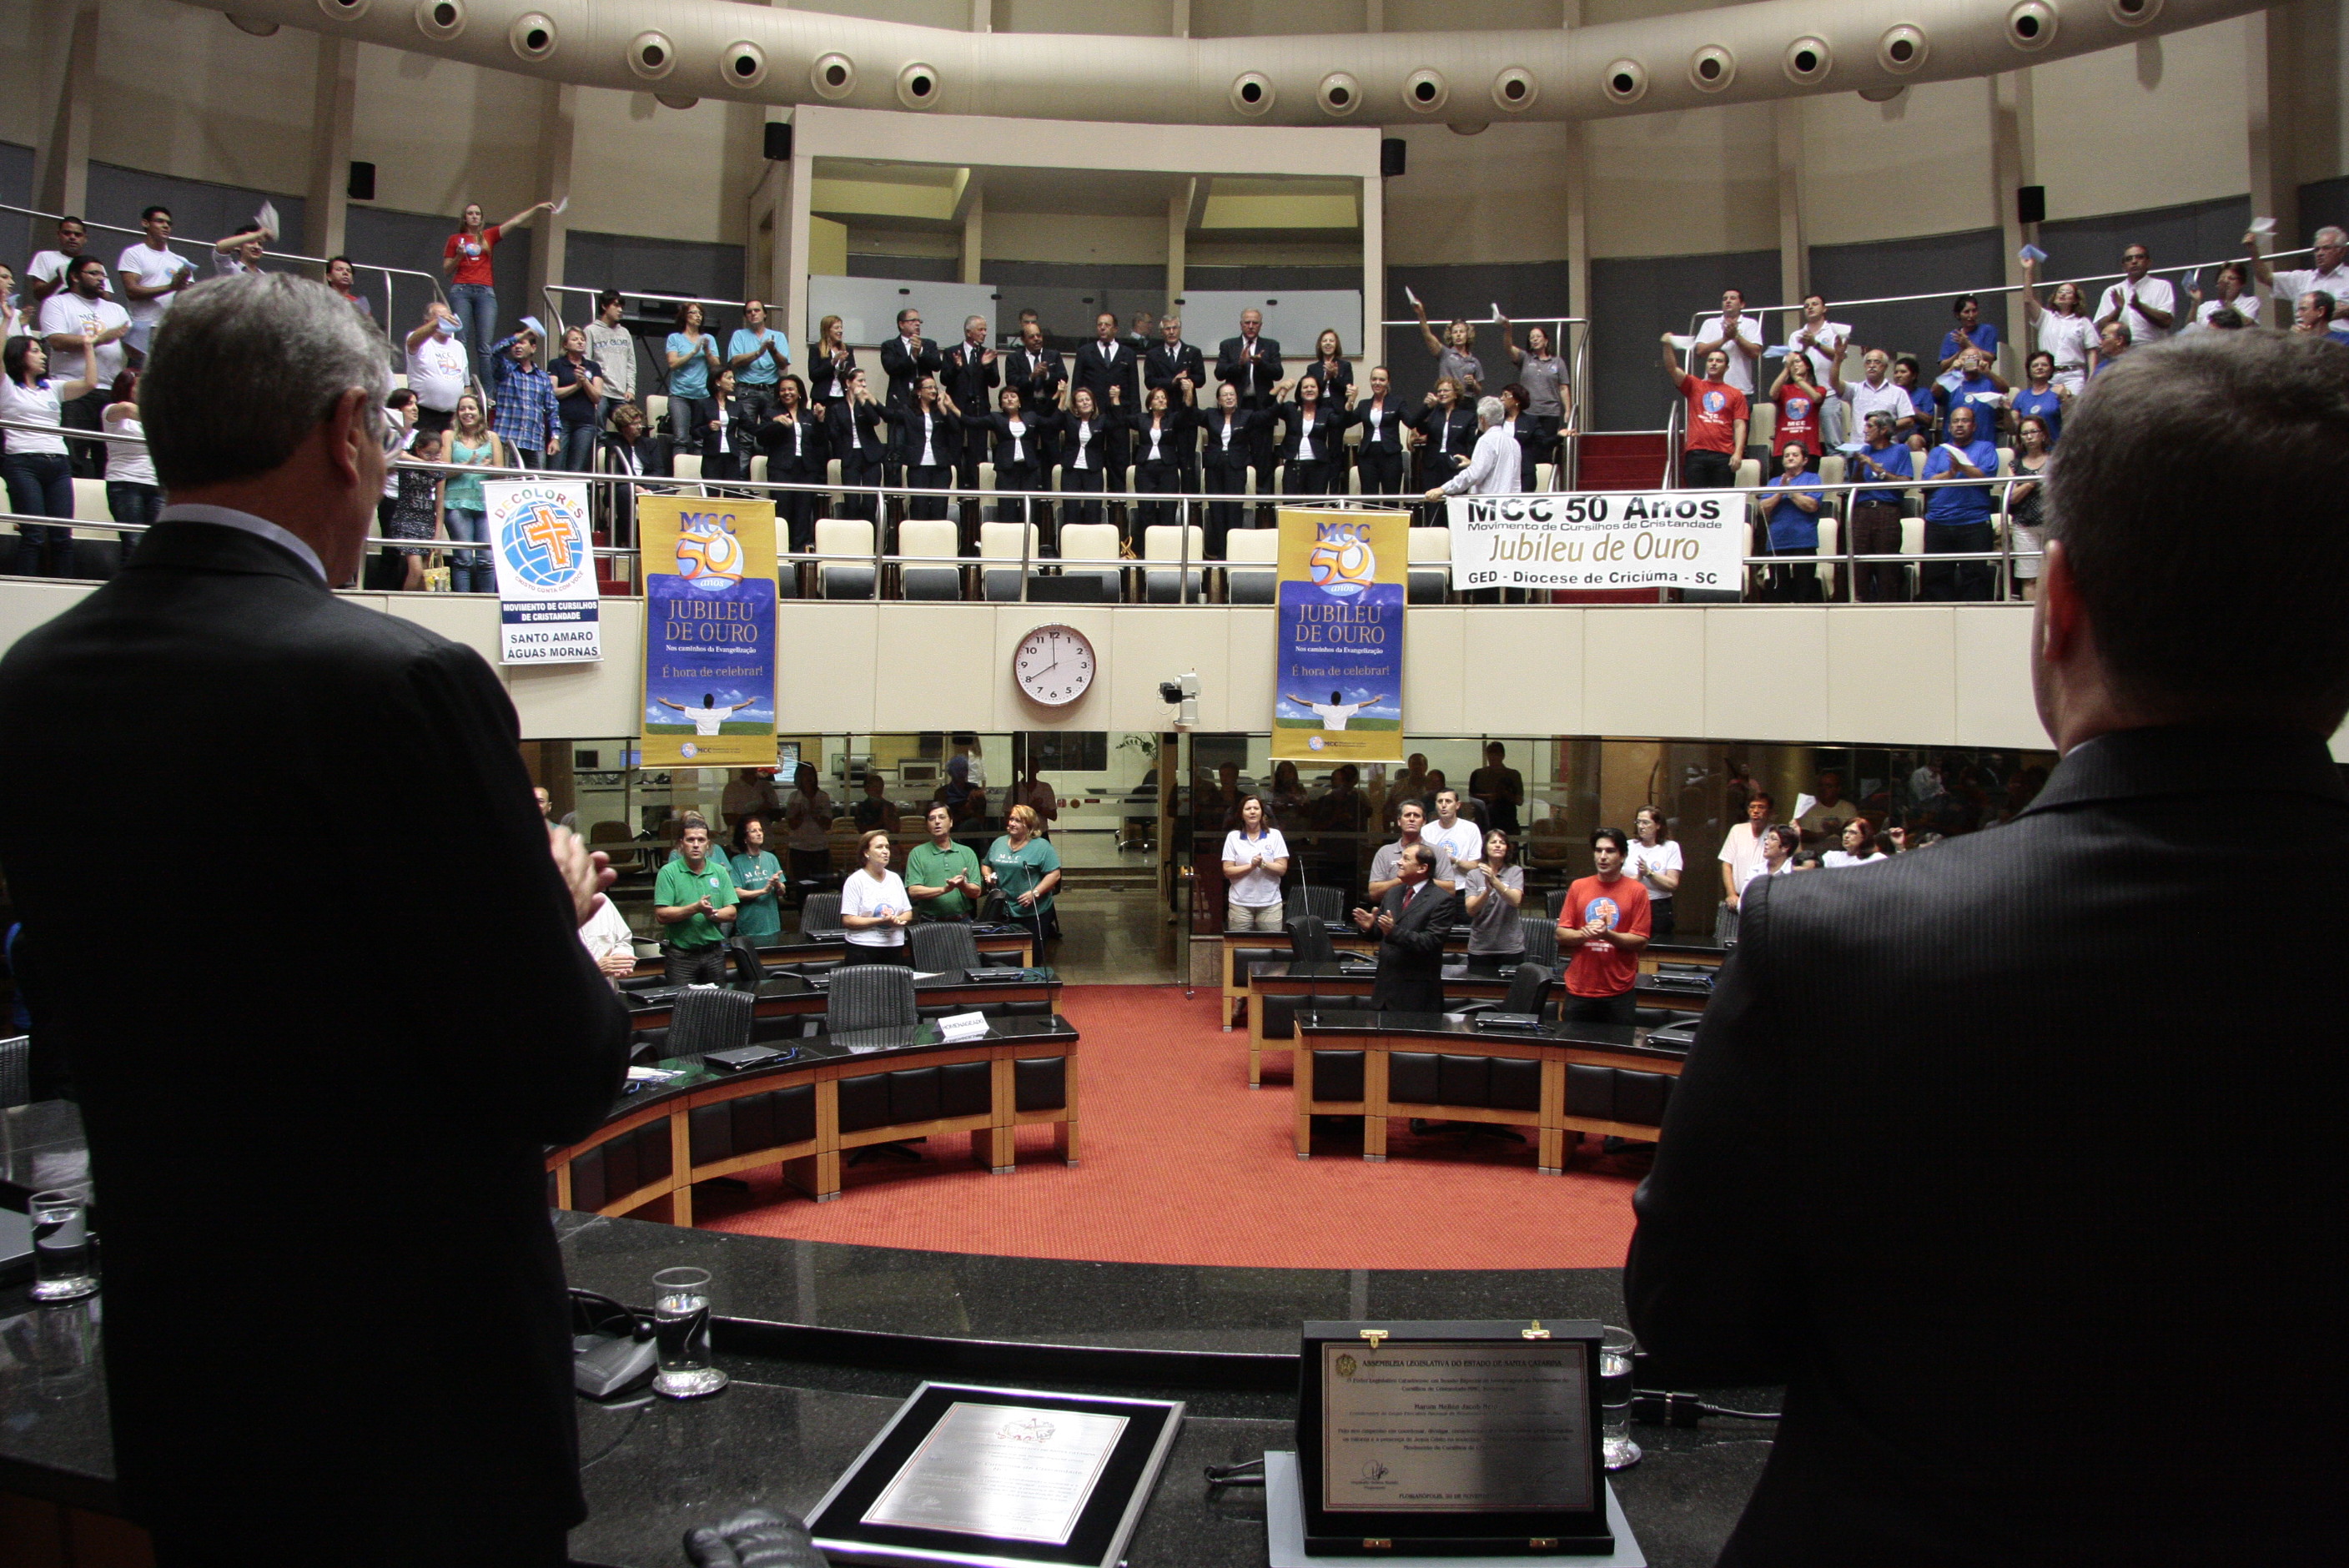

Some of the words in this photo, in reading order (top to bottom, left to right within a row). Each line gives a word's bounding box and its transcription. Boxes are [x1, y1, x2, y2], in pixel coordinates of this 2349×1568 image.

[495, 488, 584, 520] DECOLORES
[1467, 497, 1554, 523] MCC
[1566, 495, 1608, 523] 50
[1623, 495, 1721, 521] Anos
[679, 511, 736, 535] MCC
[1467, 520, 1539, 531] Movimento
[1542, 522, 1557, 530] de
[1560, 521, 1620, 531] Cursilhos
[1622, 520, 1637, 530] de
[1639, 519, 1723, 530] Cristandade
[1315, 522, 1371, 543] MCC
[677, 530, 739, 580] 50
[1592, 532, 1625, 562] de
[1632, 531, 1700, 560] Ouro
[1310, 539, 1371, 586] 50
[701, 578, 724, 588] anos
[1468, 570, 1498, 584] GED
[1513, 571, 1578, 584] Diocese
[1583, 572, 1603, 584] de
[1609, 569, 1678, 584] Criciúma
[1695, 572, 1718, 585] SC
[558, 582, 571, 592] COM
[1330, 584, 1354, 592] anos
[503, 603, 546, 611] MOVIMENTO
[557, 601, 597, 611] CURSILHOS
[668, 600, 753, 621] JUBILEU
[1299, 604, 1382, 624] JUBILEU
[521, 613, 532, 621] DE
[532, 611, 581, 621] CRISTANDADE
[511, 632, 549, 643] SANTO
[552, 631, 593, 642] AMARO
[665, 621, 693, 641] DE
[700, 622, 758, 643] OURO
[1295, 625, 1321, 642] DE
[1328, 626, 1385, 644] OURO
[507, 646, 546, 659] ÁGUAS
[549, 646, 598, 657] MORNAS
[672, 666, 697, 677] hora
[700, 666, 713, 676] de
[716, 666, 763, 676] celebrar!
[1301, 666, 1325, 676] hora
[1328, 666, 1340, 676] de
[1343, 666, 1390, 676] celebrar!
